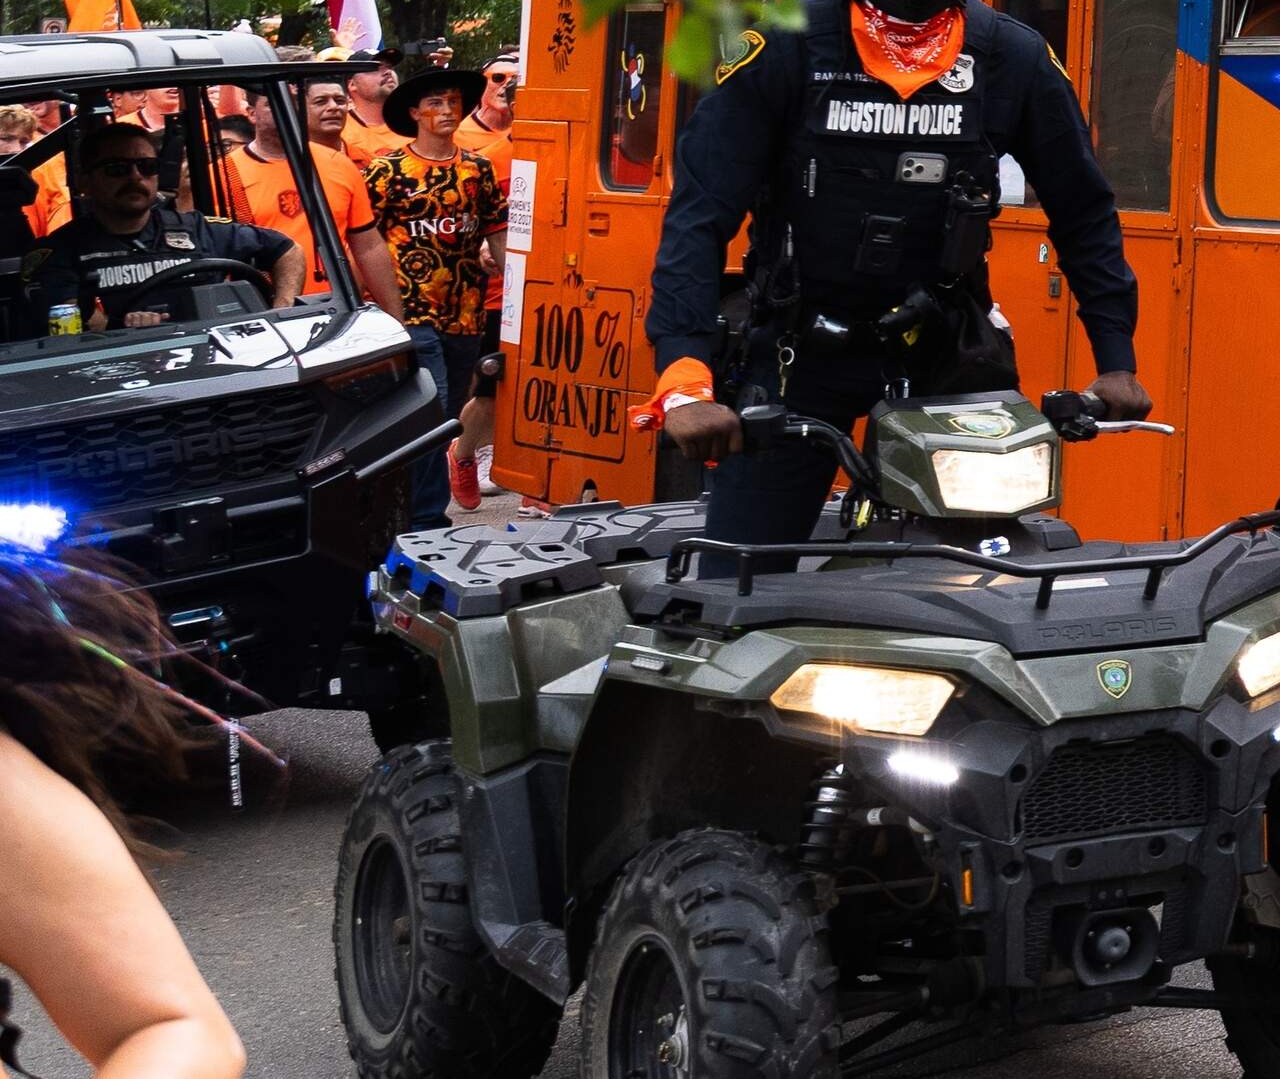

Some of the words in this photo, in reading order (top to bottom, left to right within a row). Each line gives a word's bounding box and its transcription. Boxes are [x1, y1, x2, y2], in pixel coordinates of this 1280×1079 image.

[826, 100, 906, 134] HOUSTON
[908, 104, 963, 135] POLICE
[408, 217, 457, 237] ING
[530, 303, 584, 373] 100
[595, 310, 625, 379] %
[524, 377, 621, 437] ORANJE
[1037, 616, 1176, 641] POLARIS
